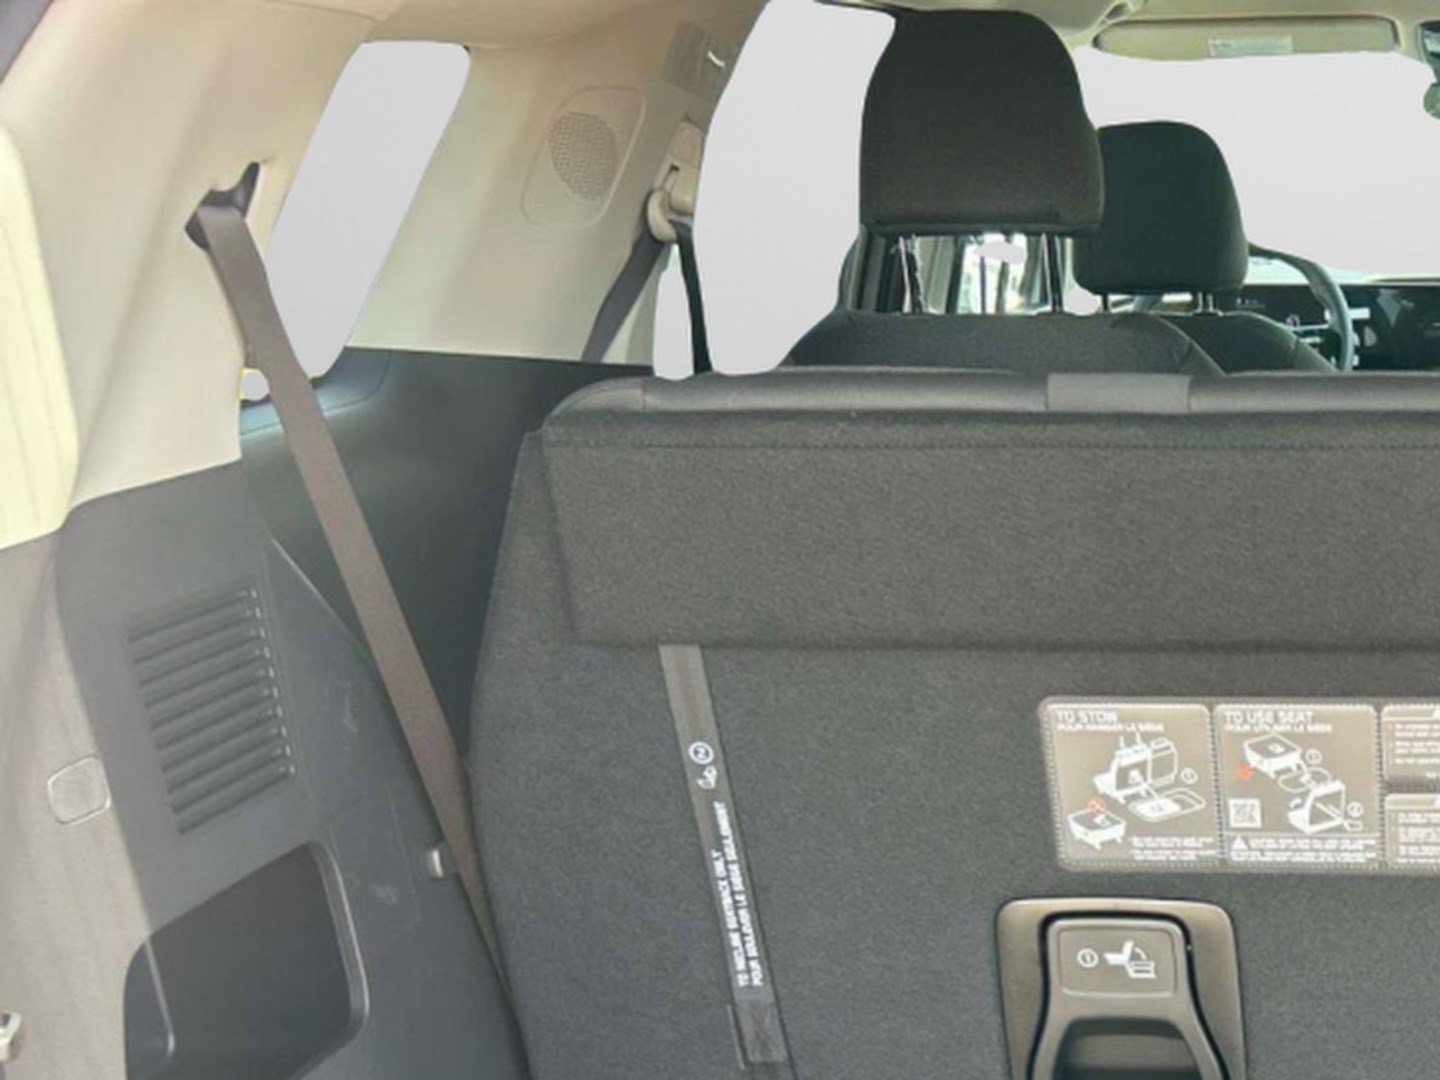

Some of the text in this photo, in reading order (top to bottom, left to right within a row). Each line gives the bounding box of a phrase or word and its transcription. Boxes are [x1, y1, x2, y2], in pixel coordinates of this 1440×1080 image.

[1056, 710, 1075, 722] TO
[1225, 710, 1314, 723] TO USE SEAT
[711, 849, 727, 880] ONLY
